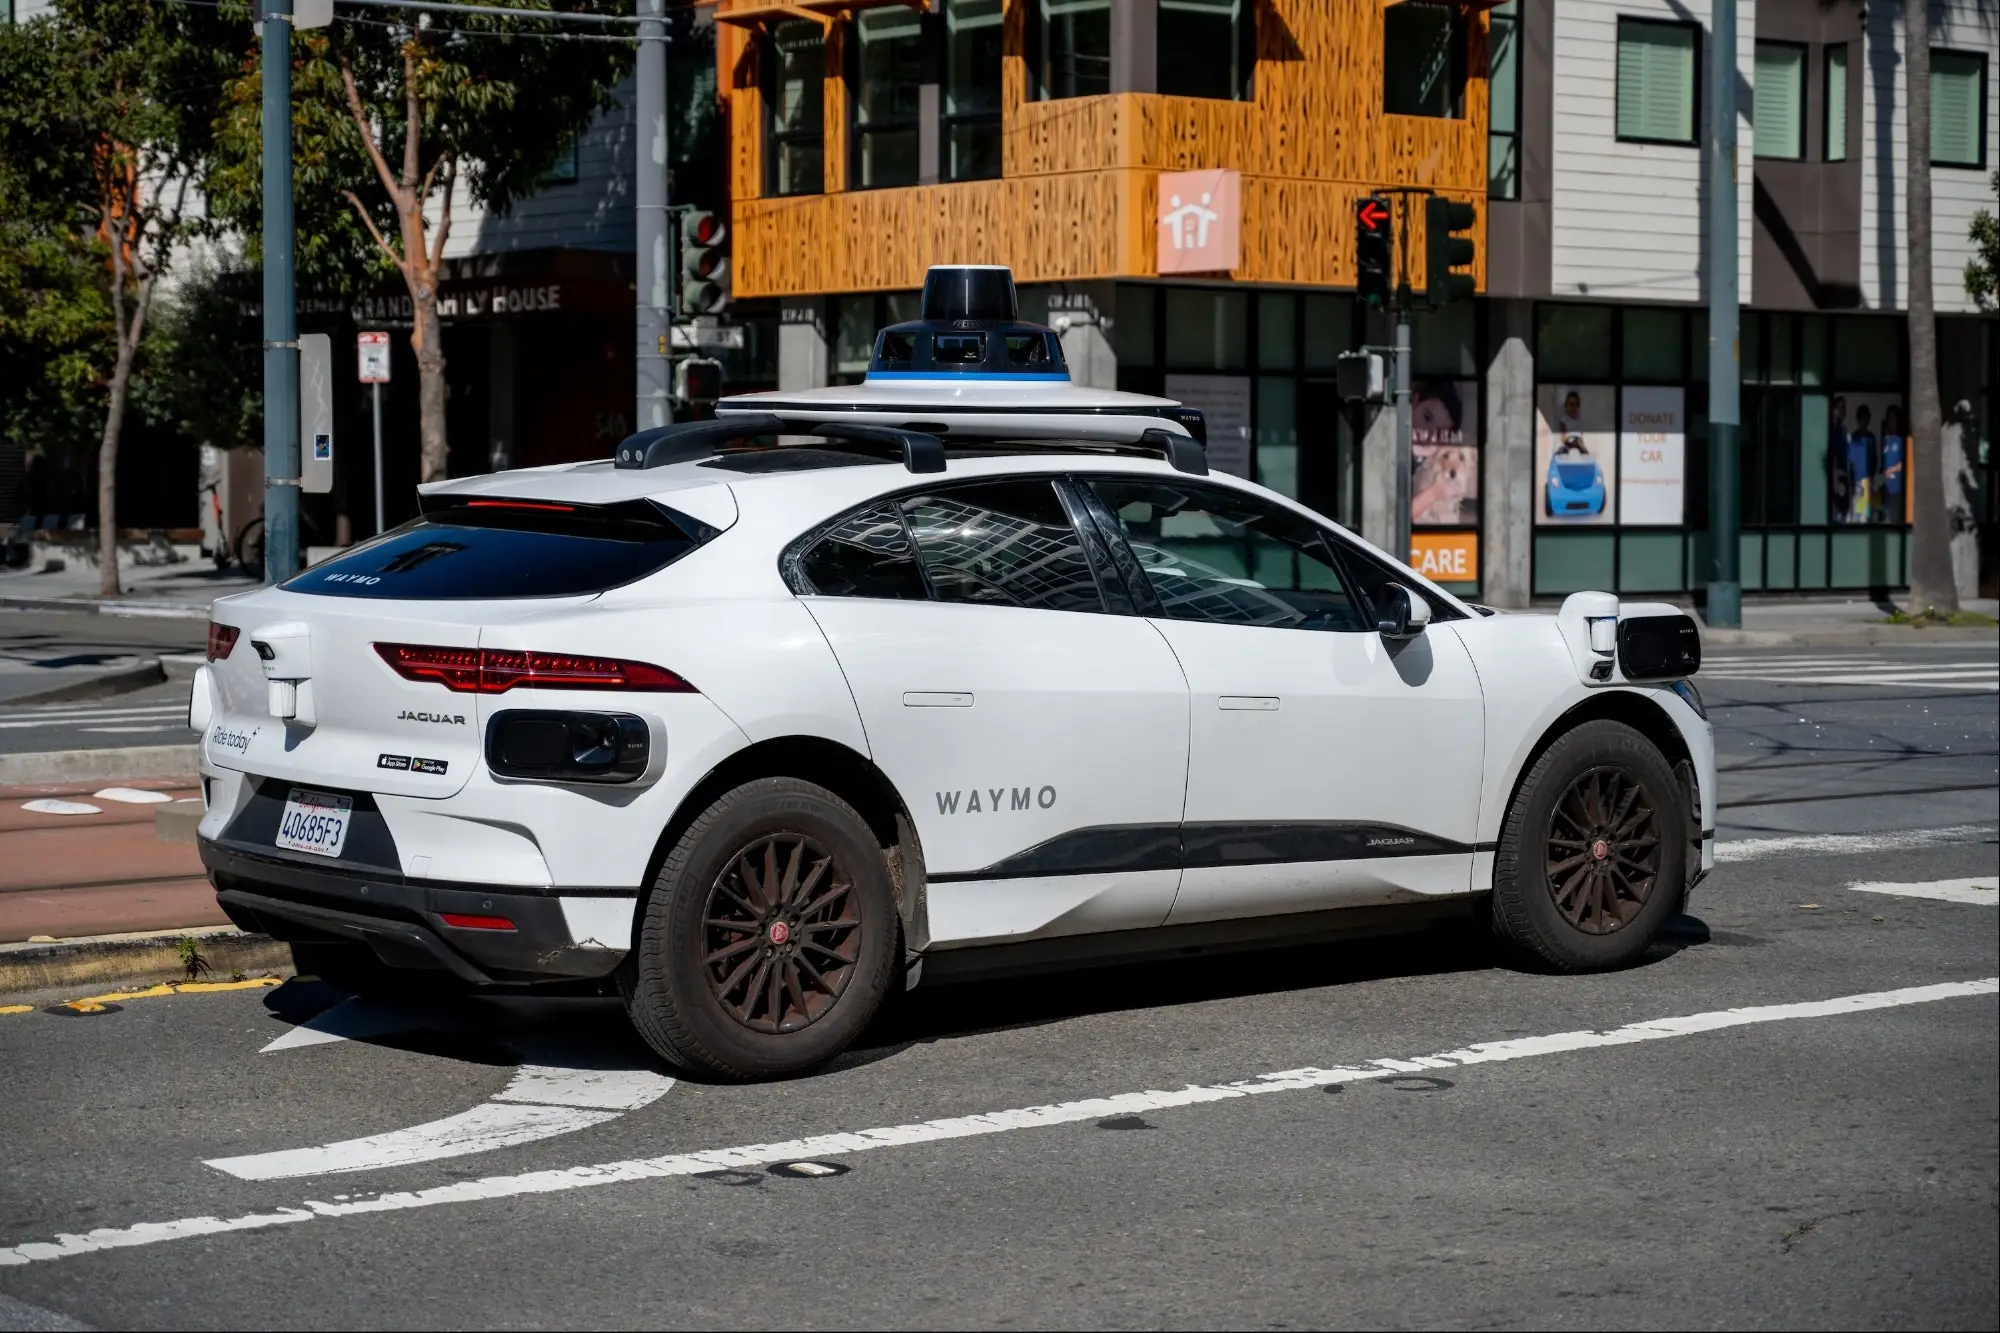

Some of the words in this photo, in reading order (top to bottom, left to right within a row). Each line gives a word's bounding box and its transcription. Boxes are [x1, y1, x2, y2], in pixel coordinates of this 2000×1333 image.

[492, 284, 561, 313] HOUSE
[1628, 412, 1675, 426] DONATE
[1637, 430, 1668, 444] YOUR
[1640, 450, 1664, 463] CAR
[324, 573, 381, 585] WAYMO
[397, 710, 465, 725] JAGUAR
[212, 726, 228, 745] Ride
[227, 730, 251, 755] today
[420, 763, 436, 772] Google
[935, 785, 1057, 816] WAYMO
[282, 810, 343, 847] 40685F3
[1366, 837, 1415, 847] JAGUAR
